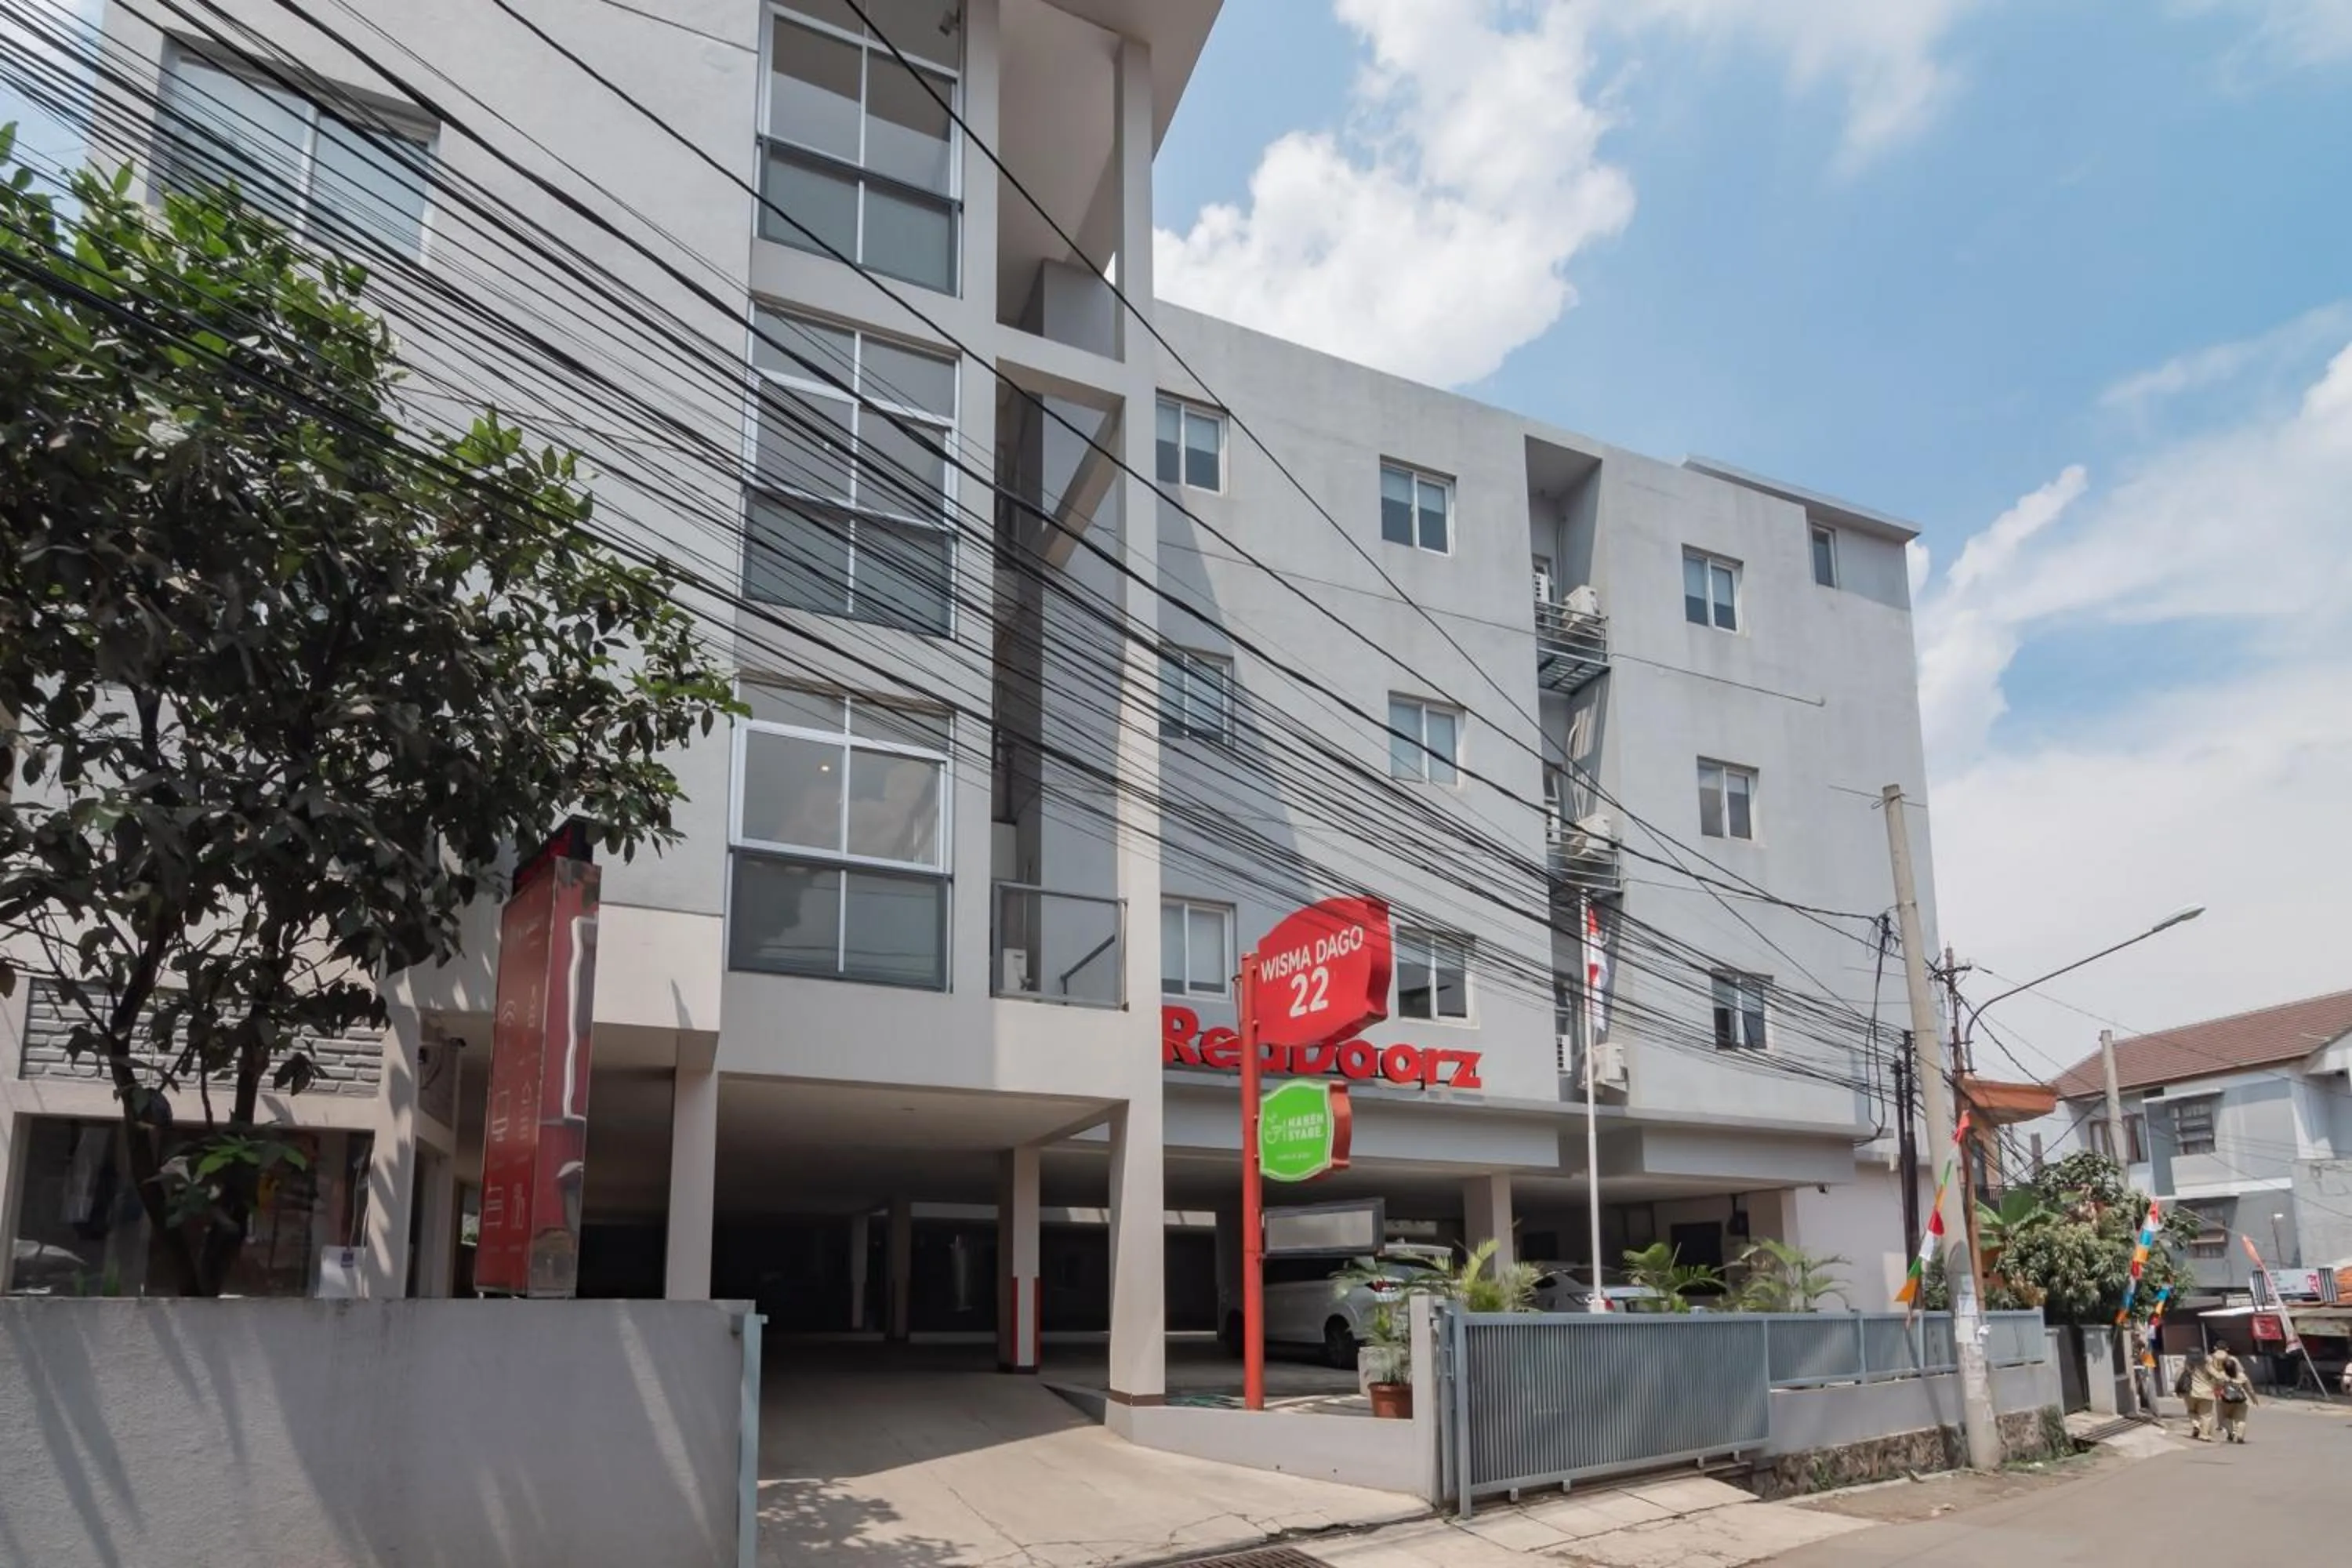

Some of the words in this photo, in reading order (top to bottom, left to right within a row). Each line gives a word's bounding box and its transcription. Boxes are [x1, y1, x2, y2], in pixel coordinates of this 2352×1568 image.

[1261, 945, 1311, 983] WISMA
[1316, 925, 1363, 964] DAGO
[1290, 966, 1329, 1018] 22
